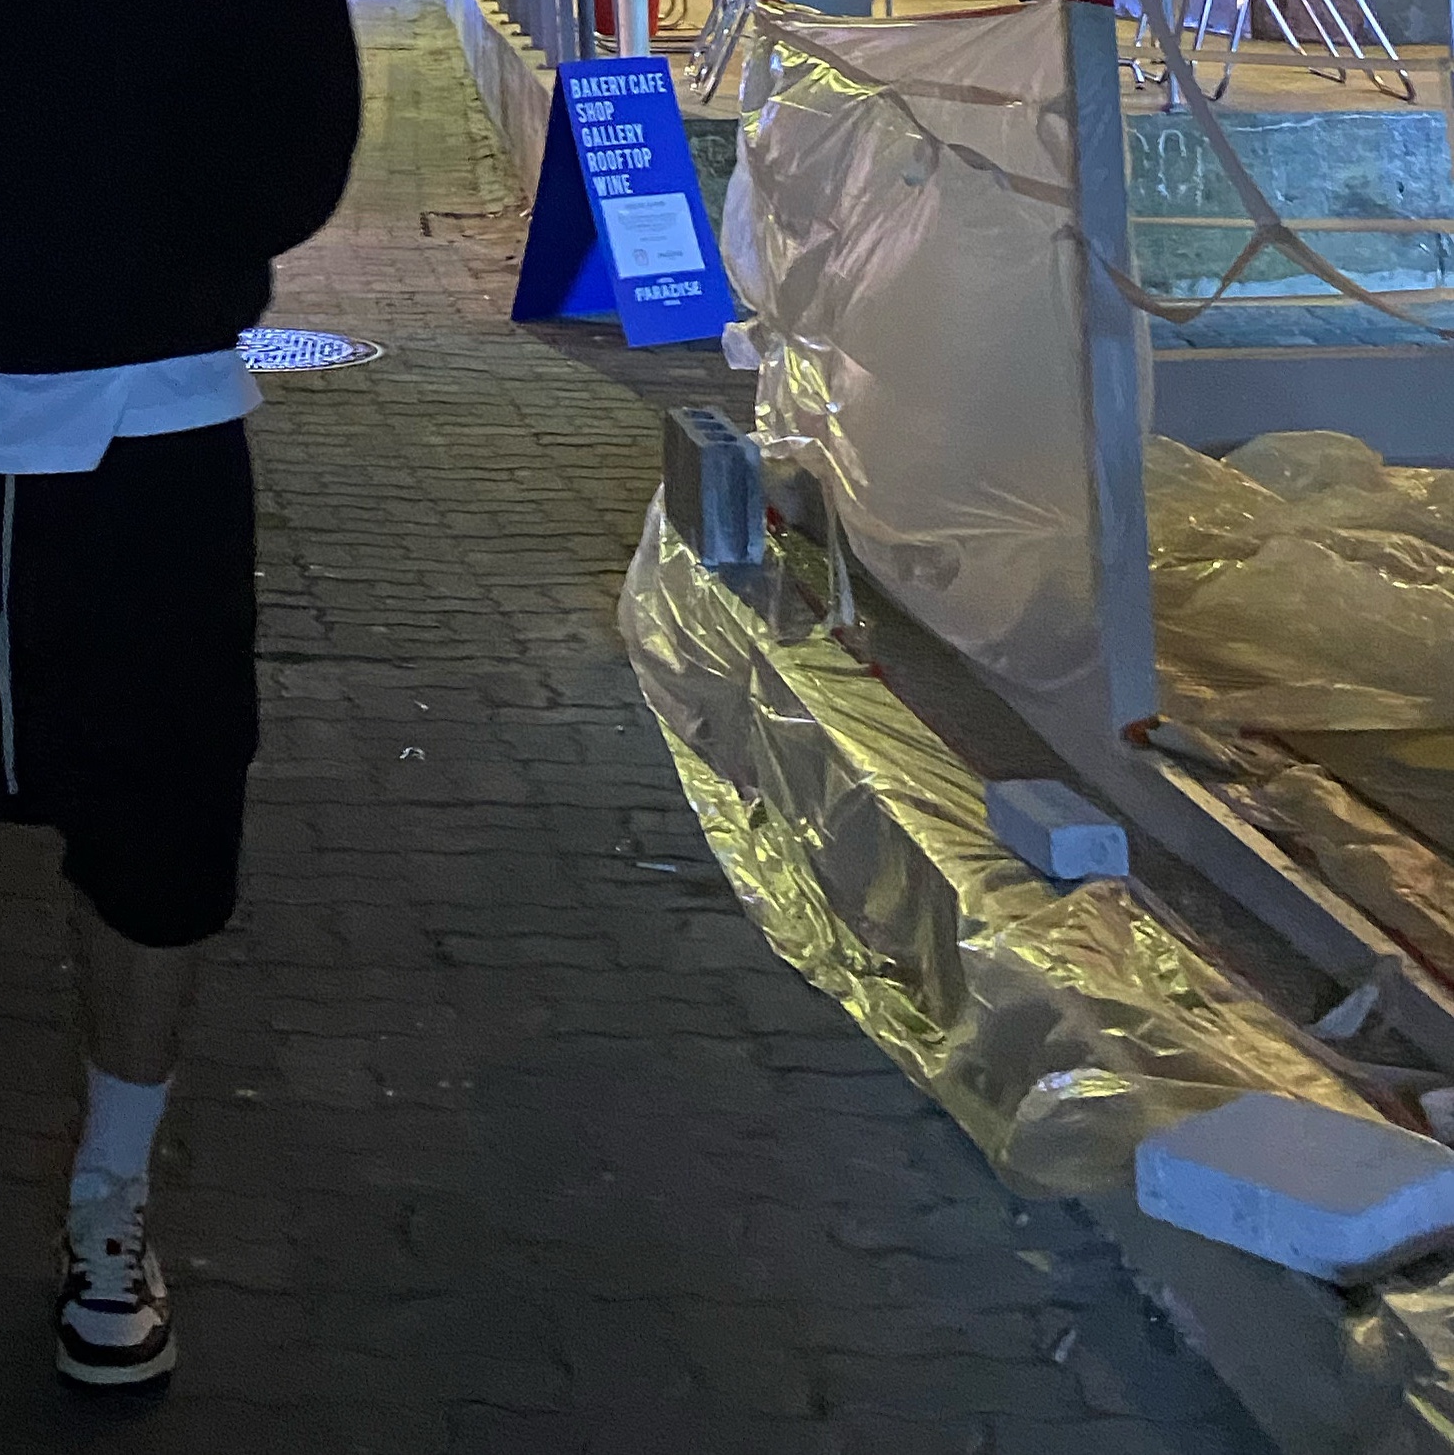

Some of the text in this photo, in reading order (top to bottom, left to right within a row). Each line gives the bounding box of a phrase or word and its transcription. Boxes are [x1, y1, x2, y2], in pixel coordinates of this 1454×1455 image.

[569, 72, 667, 99] BAKERY CAFE
[575, 101, 615, 123] SHOP
[581, 123, 645, 148] GALLERY
[586, 148, 652, 173] ROOFTOP
[592, 174, 634, 196] WINE
[634, 280, 703, 302] PARADISE
